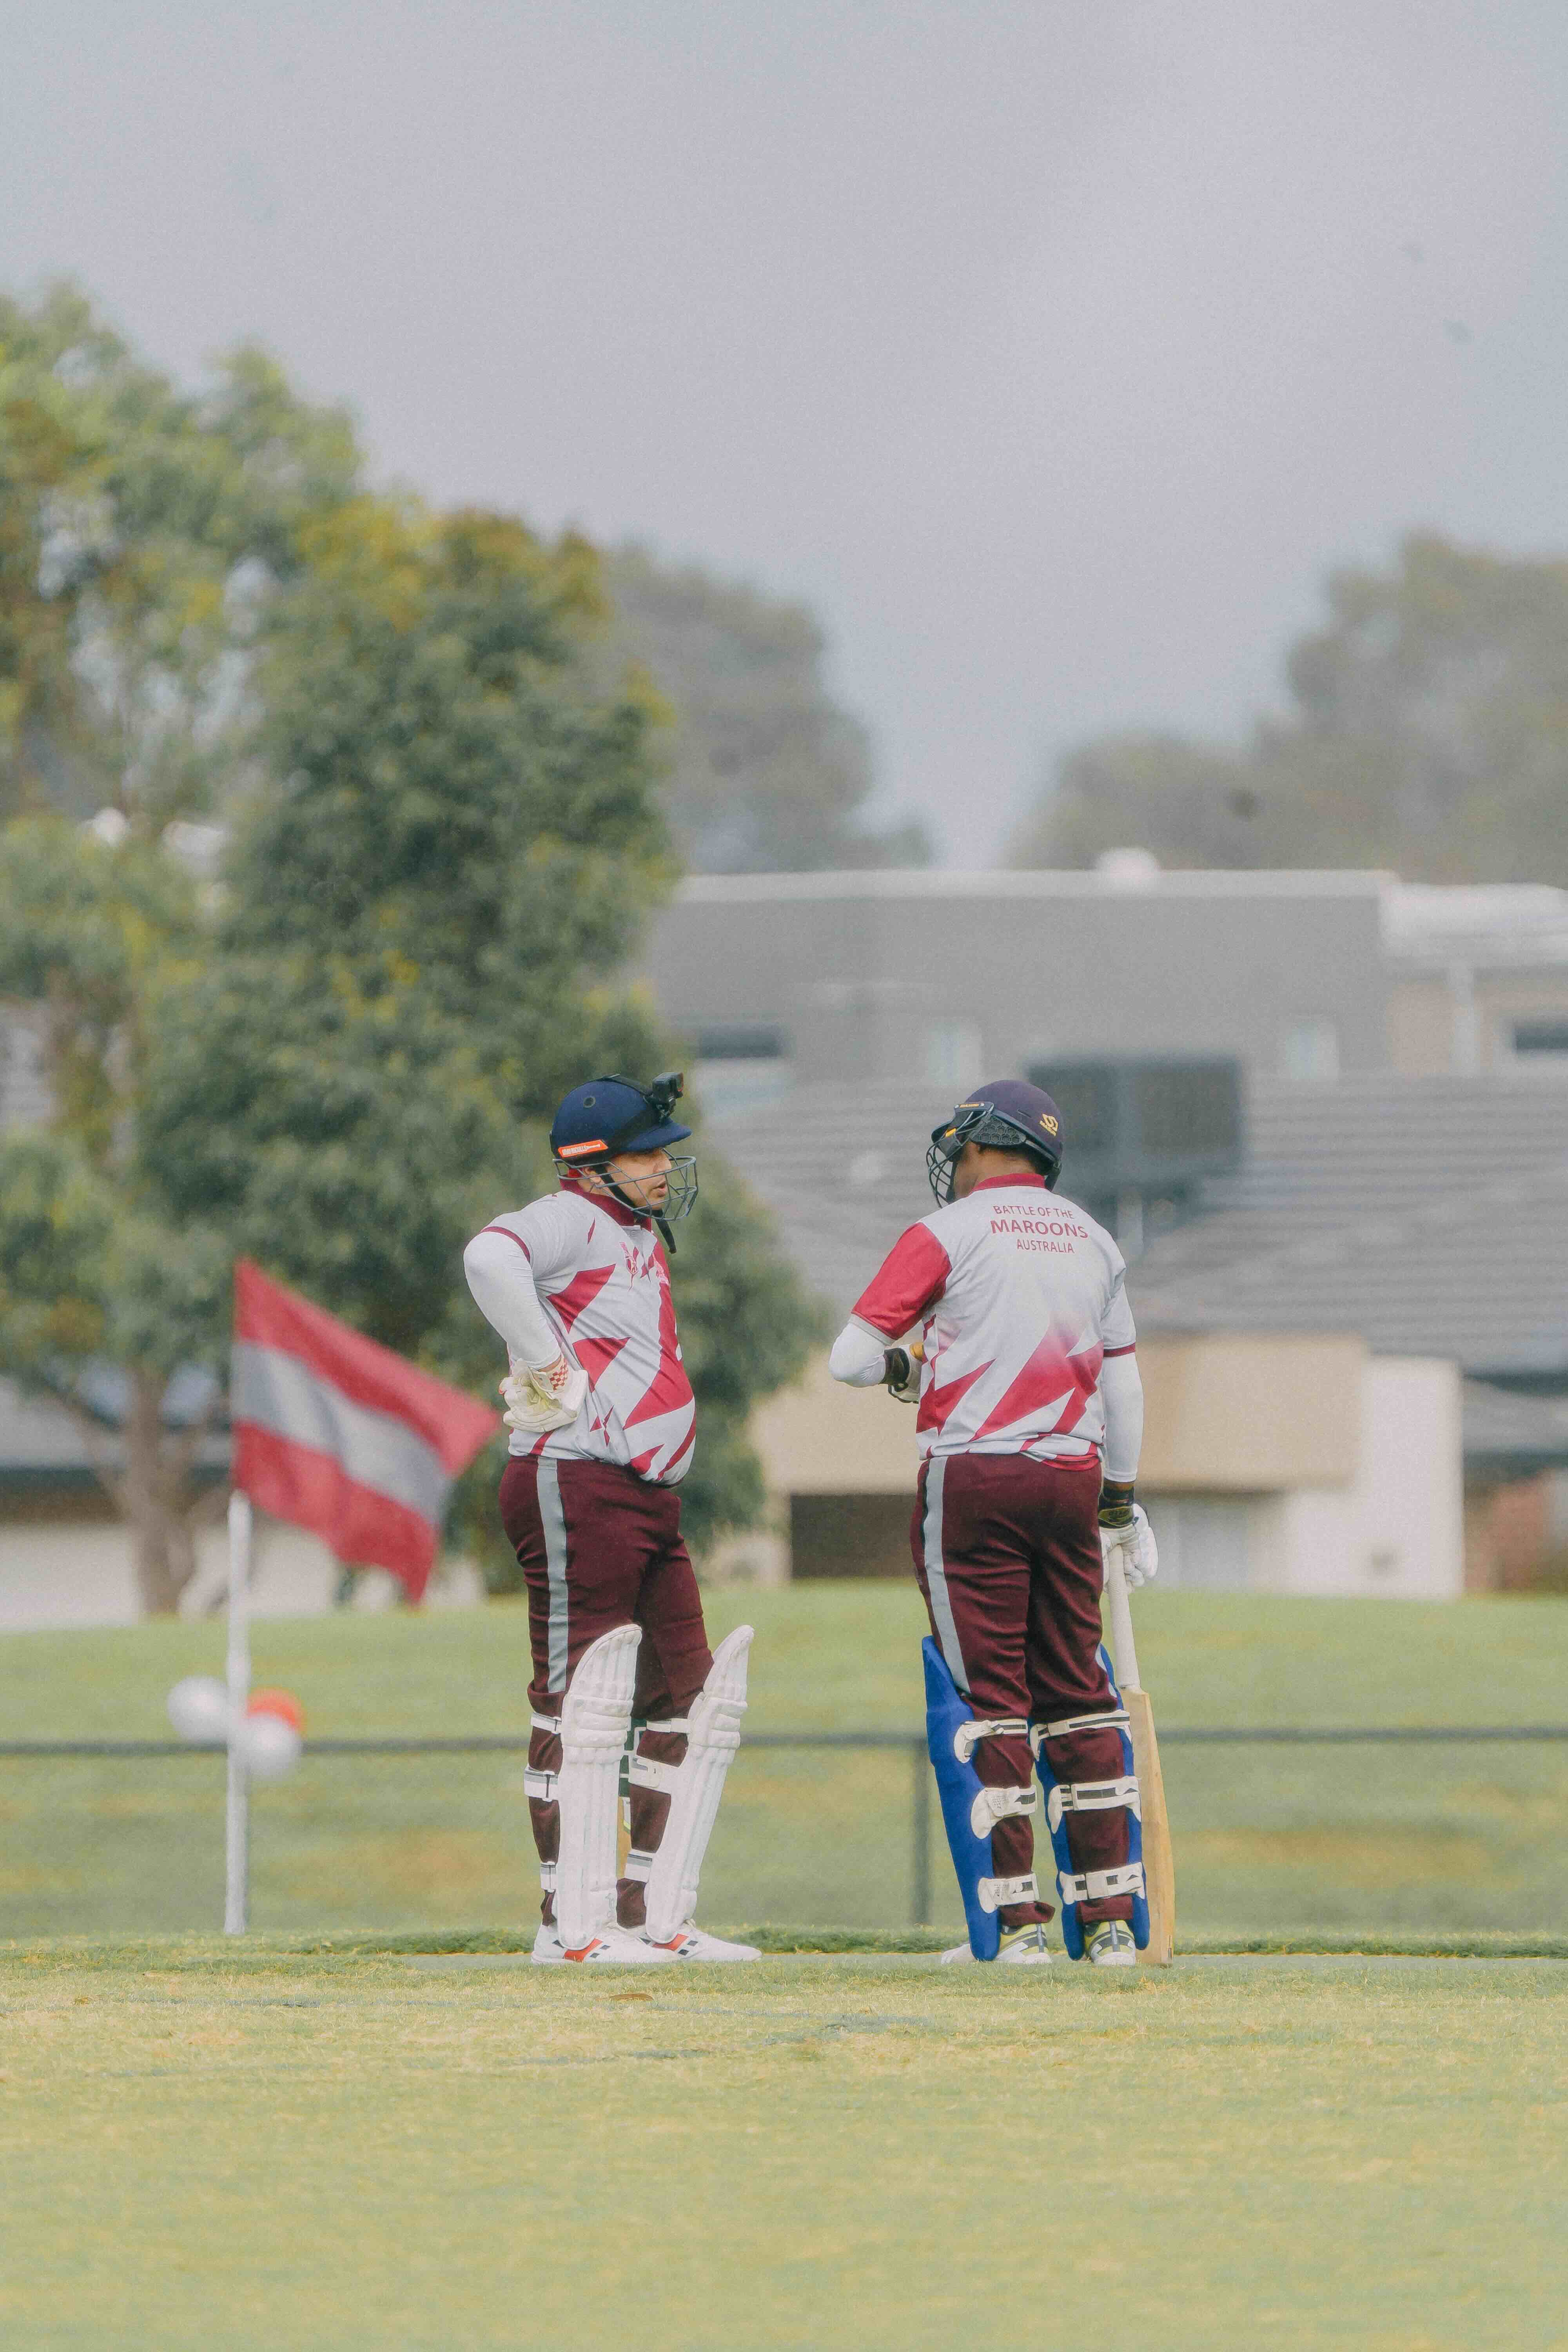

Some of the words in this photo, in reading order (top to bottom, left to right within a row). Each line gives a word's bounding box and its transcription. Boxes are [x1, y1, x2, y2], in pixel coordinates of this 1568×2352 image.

[993, 1205, 1035, 1215] BATTLE
[1038, 1207, 1051, 1216] OF
[1054, 1208, 1074, 1219] THE
[991, 1220, 1088, 1238] MAROONS
[1017, 1239, 1075, 1253] AUSTRALIA
